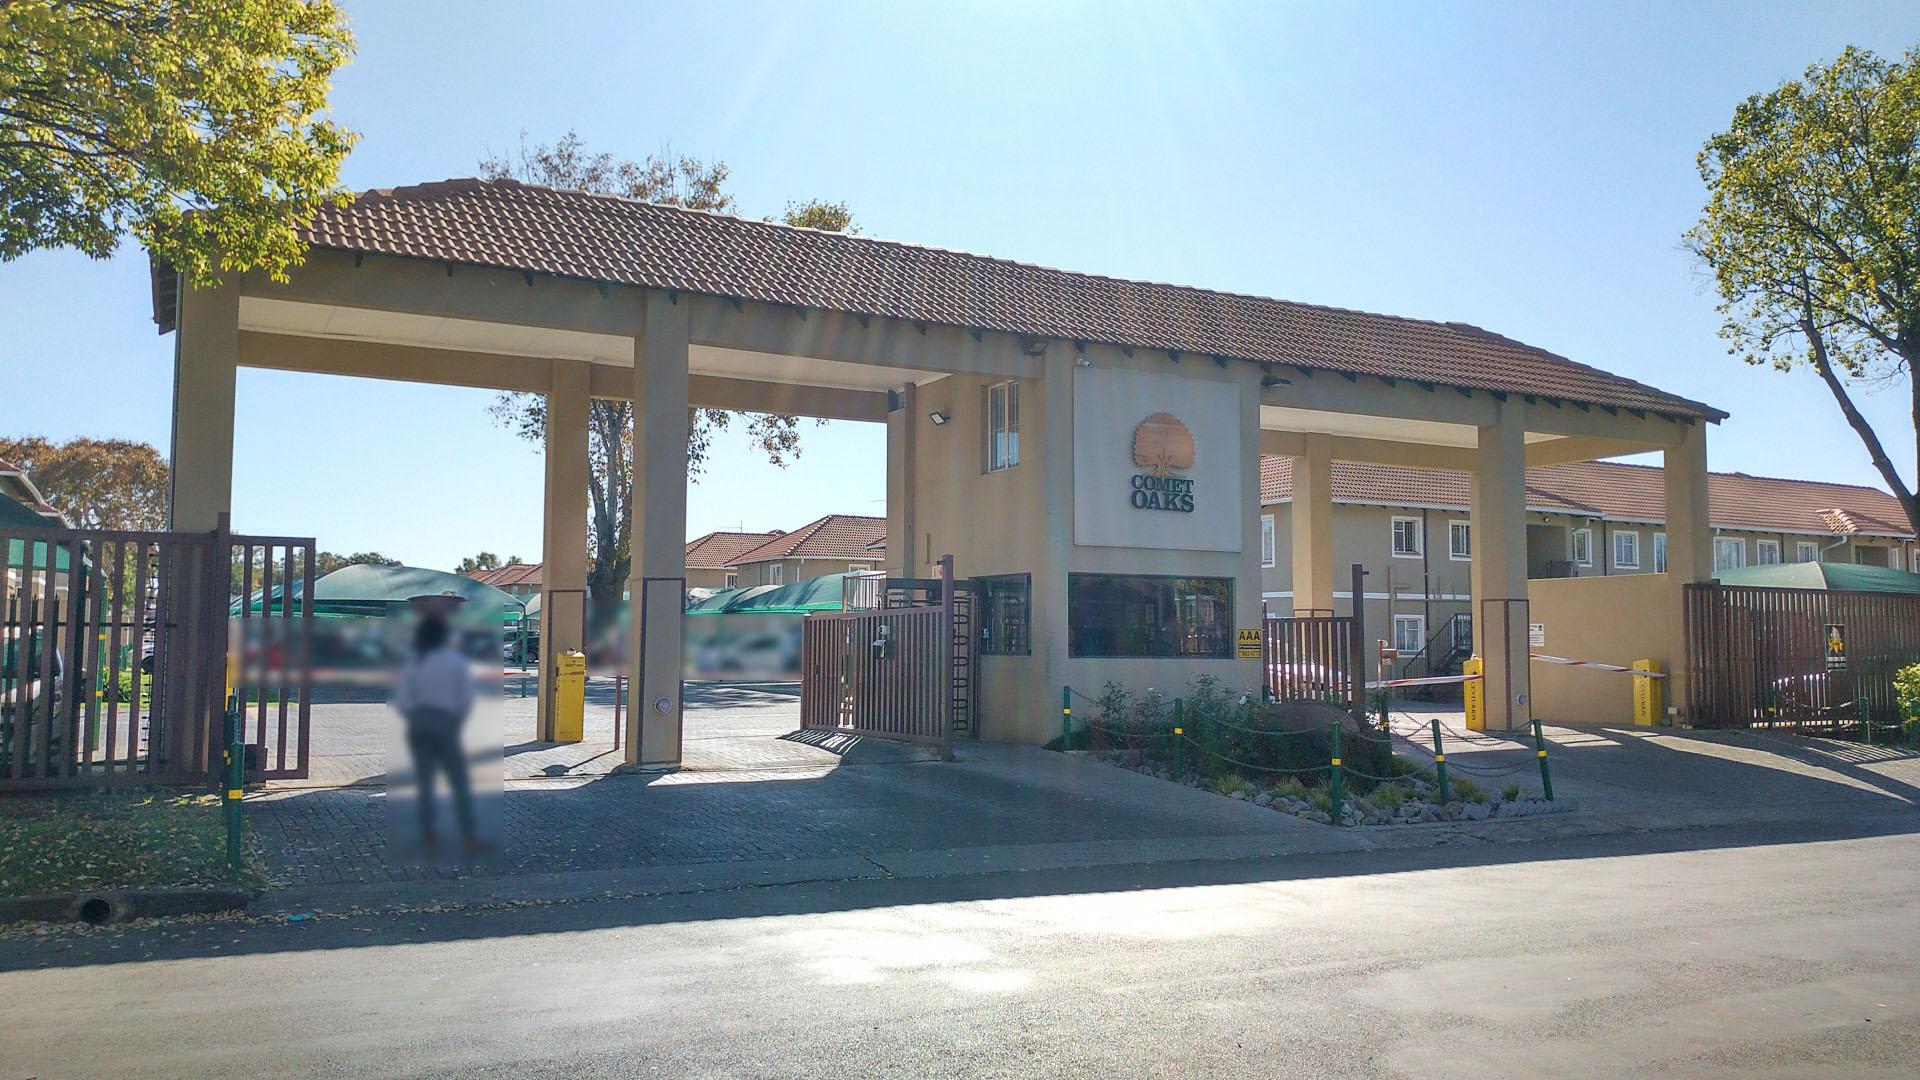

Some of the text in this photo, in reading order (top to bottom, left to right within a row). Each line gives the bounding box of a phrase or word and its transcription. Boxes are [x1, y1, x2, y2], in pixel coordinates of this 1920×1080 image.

[1131, 475, 1194, 493] COMET
[1131, 490, 1195, 513] OAKS
[1239, 630, 1260, 640] AAA
